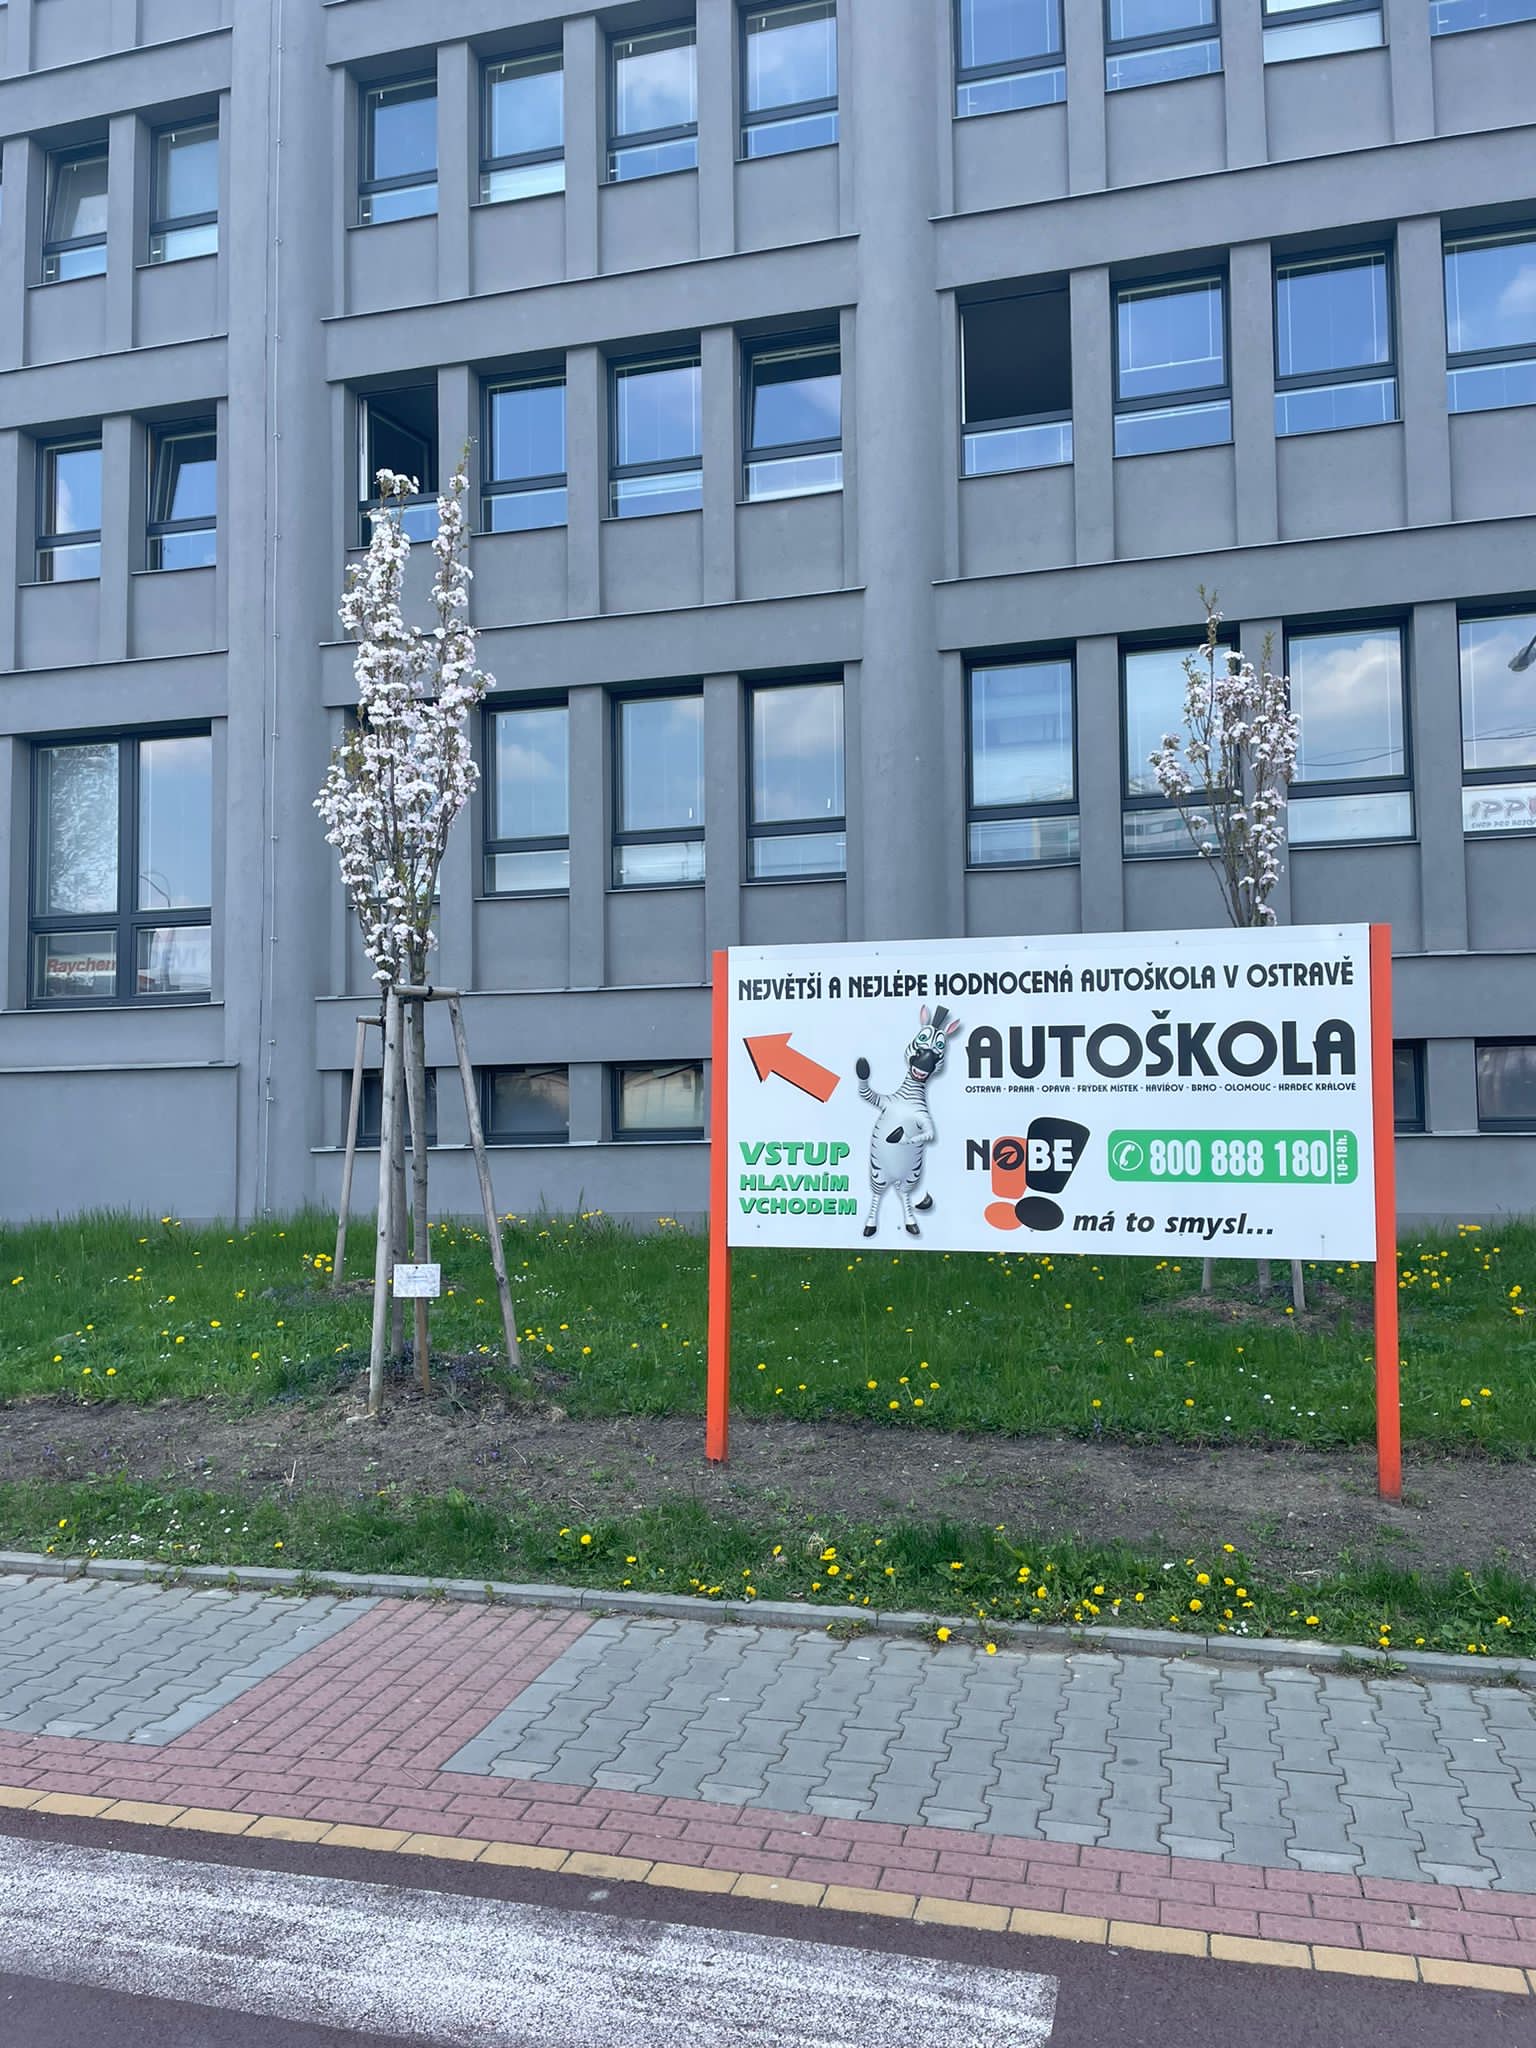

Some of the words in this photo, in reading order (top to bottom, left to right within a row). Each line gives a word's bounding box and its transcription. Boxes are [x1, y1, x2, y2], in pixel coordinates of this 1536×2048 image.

[738, 972, 822, 1001] NEJVĚTŠÍ
[828, 976, 842, 999] A
[848, 970, 928, 998] NEJLÉPE
[934, 964, 1073, 996] HODNOCENÁ
[1081, 961, 1216, 992] AUTOŠKOLA
[1223, 965, 1239, 988] V
[1246, 955, 1354, 988] OSTRAVĚ
[965, 1009, 1357, 1079] AUTOŠKOLA
[965, 1084, 1002, 1093] OSTRAVA
[1008, 1084, 1035, 1093] PRAHA
[1041, 1084, 1071, 1093] OPAVA
[1191, 1083, 1217, 1092] BRNO
[1224, 1082, 1271, 1092] OLOMOUC
[1278, 1082, 1314, 1091] HRADEC
[739, 1141, 850, 1166] VSTUP
[966, 1138, 1074, 1172] NOBE
[1150, 1139, 1201, 1176] 800
[1211, 1139, 1264, 1177] 888
[1274, 1139, 1328, 1177] 180
[1336, 1134, 1348, 1178] 10-18h.
[740, 1171, 849, 1191] HLAVNÍM
[739, 1197, 857, 1215] VCHODEM
[1072, 1210, 1116, 1232] má
[1126, 1212, 1155, 1233] to
[1164, 1213, 1274, 1241] smysl...
